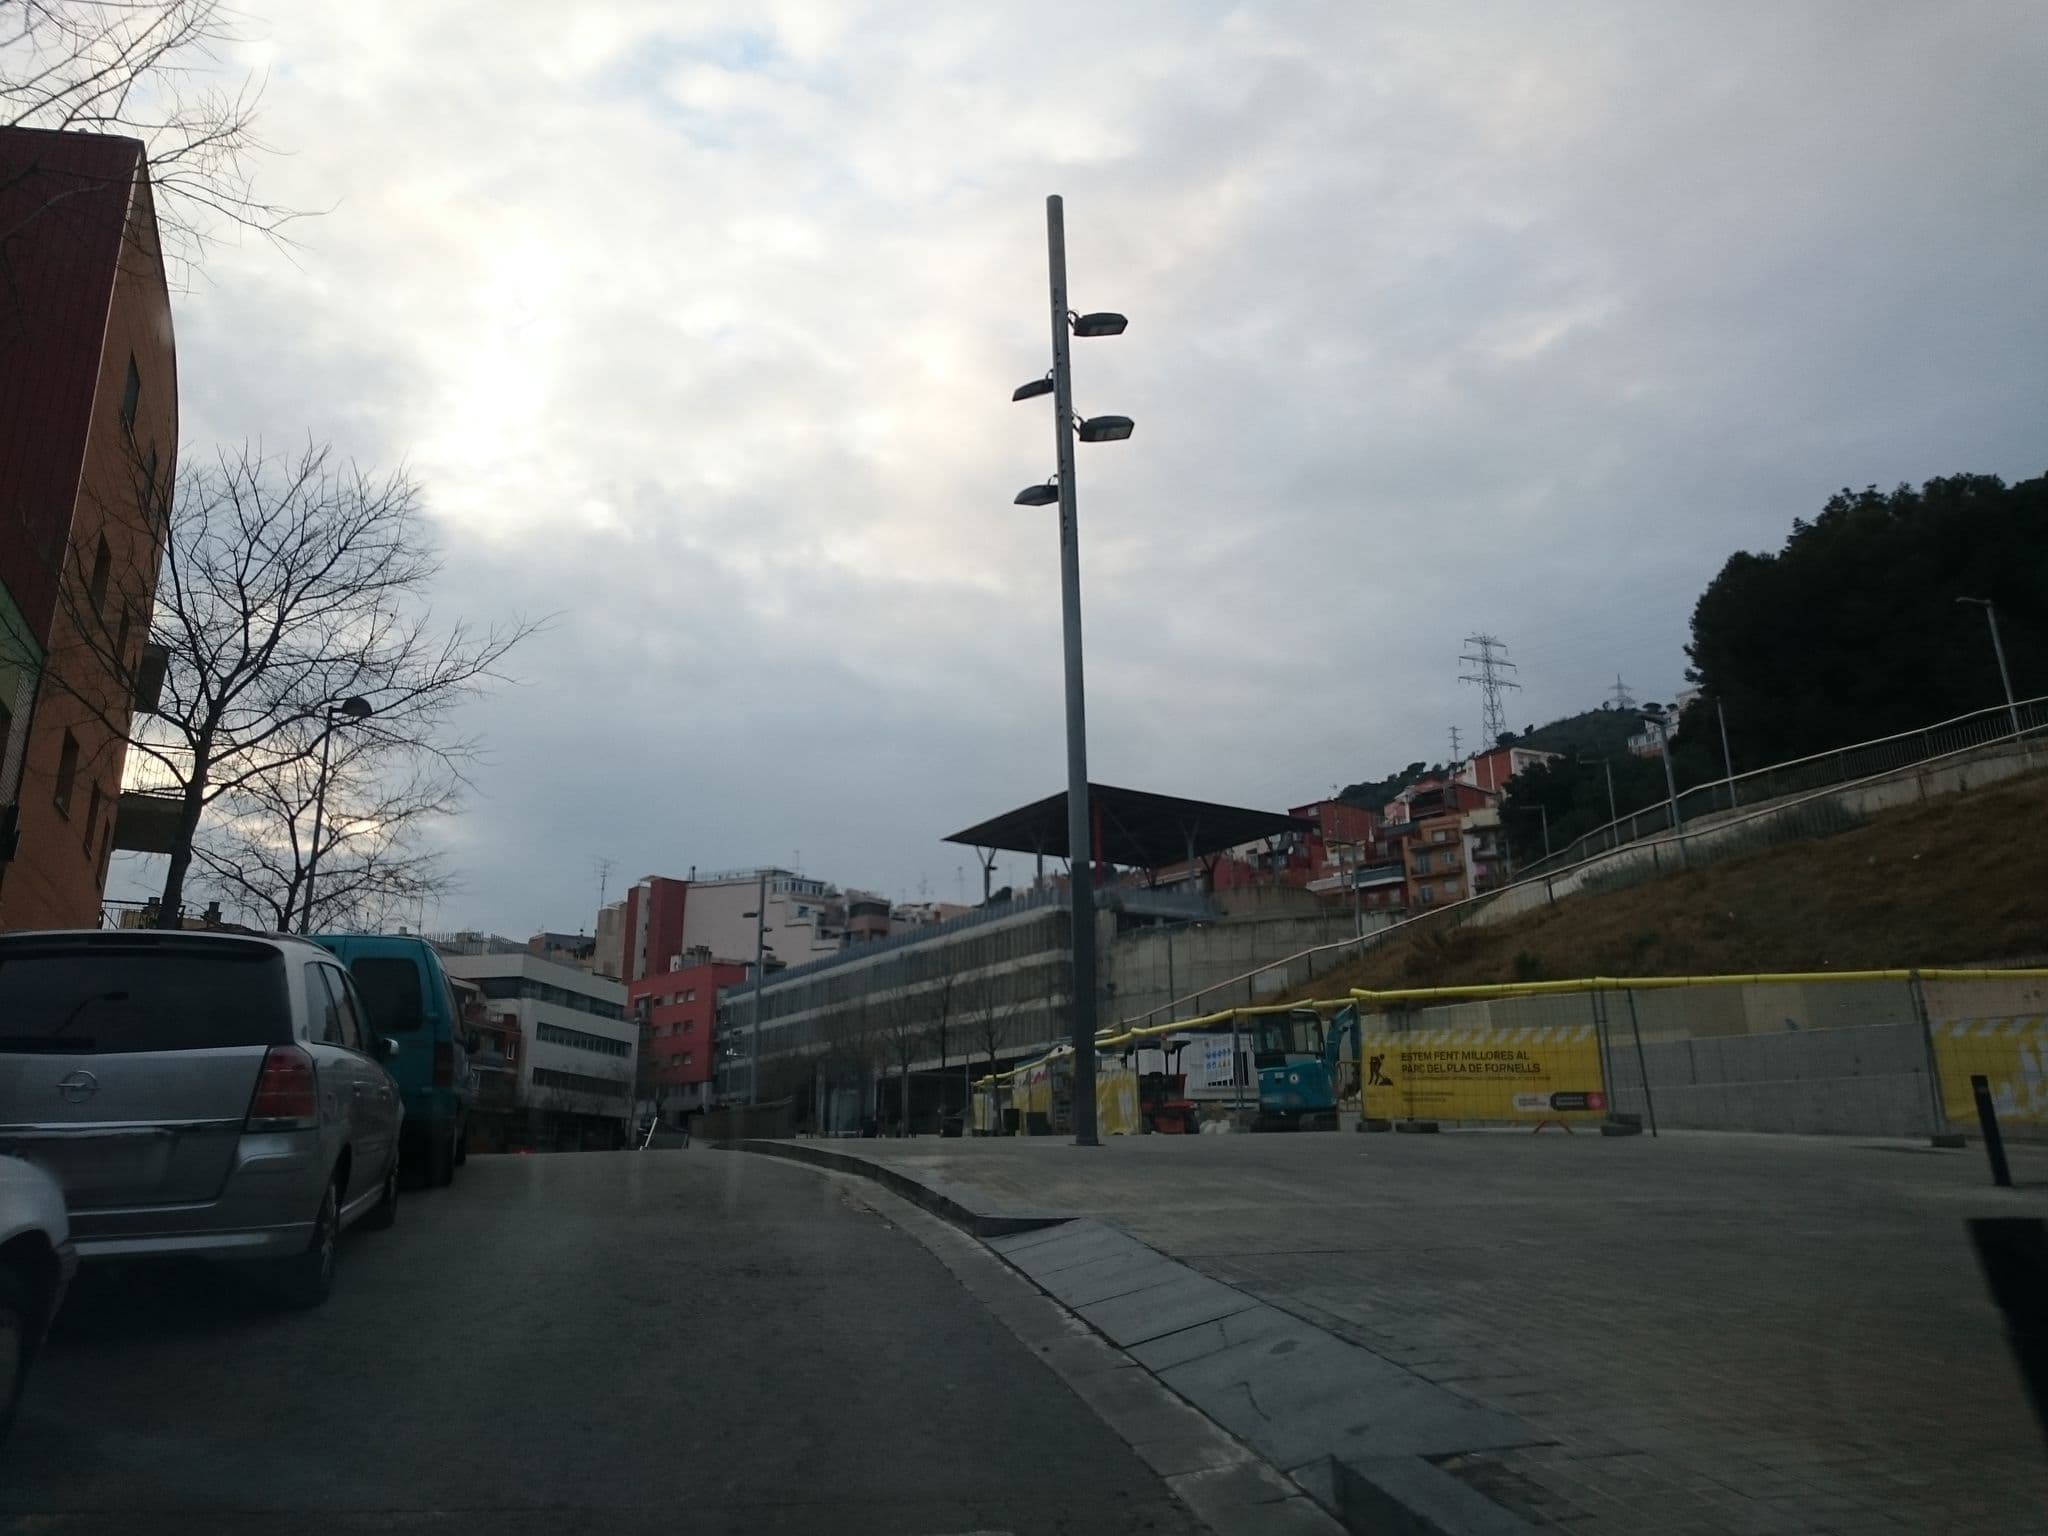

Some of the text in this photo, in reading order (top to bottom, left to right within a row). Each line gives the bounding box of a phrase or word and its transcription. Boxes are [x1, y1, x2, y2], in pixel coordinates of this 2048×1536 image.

[1401, 1050, 1530, 1061] ESTEM FENT MILLORES AL
[1402, 1063, 1541, 1073] PARC DEL PLA DE FORNELLS
